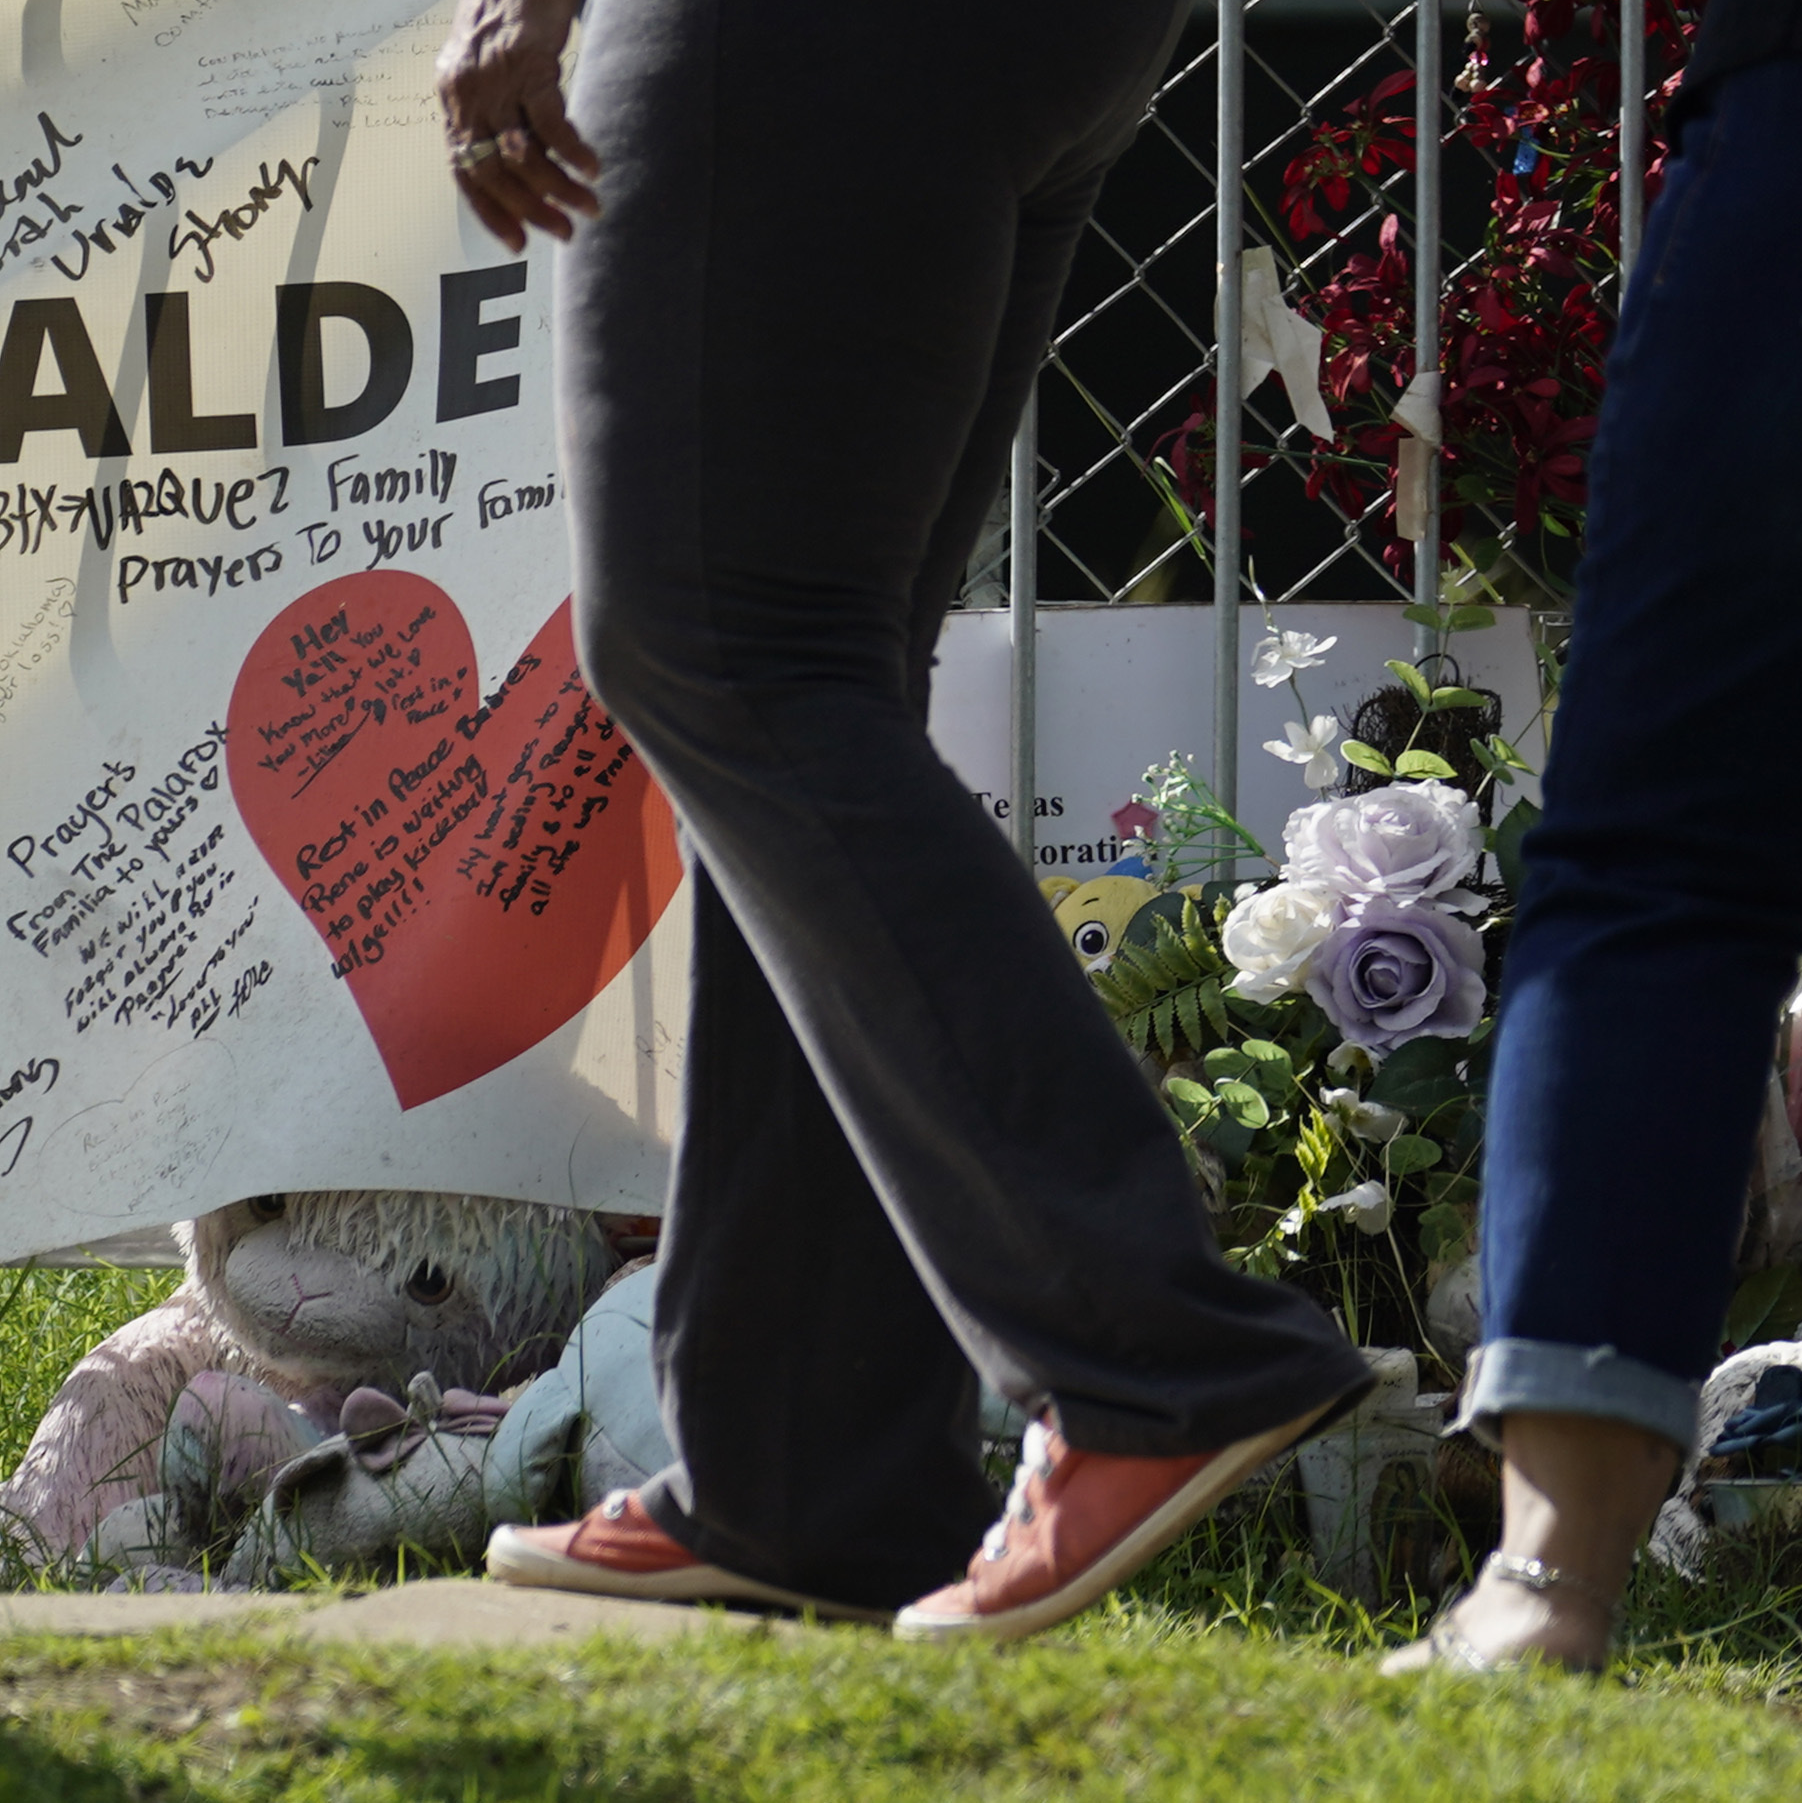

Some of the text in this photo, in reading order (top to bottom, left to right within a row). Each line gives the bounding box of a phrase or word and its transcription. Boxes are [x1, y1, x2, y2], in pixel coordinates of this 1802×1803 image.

[0, 260, 528, 465] ALDE
[327, 448, 458, 512] Family
[116, 538, 283, 605] prayers
[364, 510, 454, 572] your
[477, 472, 567, 530] Fami
[290, 609, 350, 661] Hey
[257, 702, 316, 747] Know
[296, 819, 358, 881] Rest
[353, 798, 390, 827] in
[387, 738, 455, 803] Peace
[971, 792, 1064, 819] Teas
[115, 857, 144, 885] to
[301, 859, 369, 914] Rene
[370, 835, 400, 860] is
[5, 888, 77, 941] from
[327, 912, 355, 941] to
[356, 867, 406, 921] play
